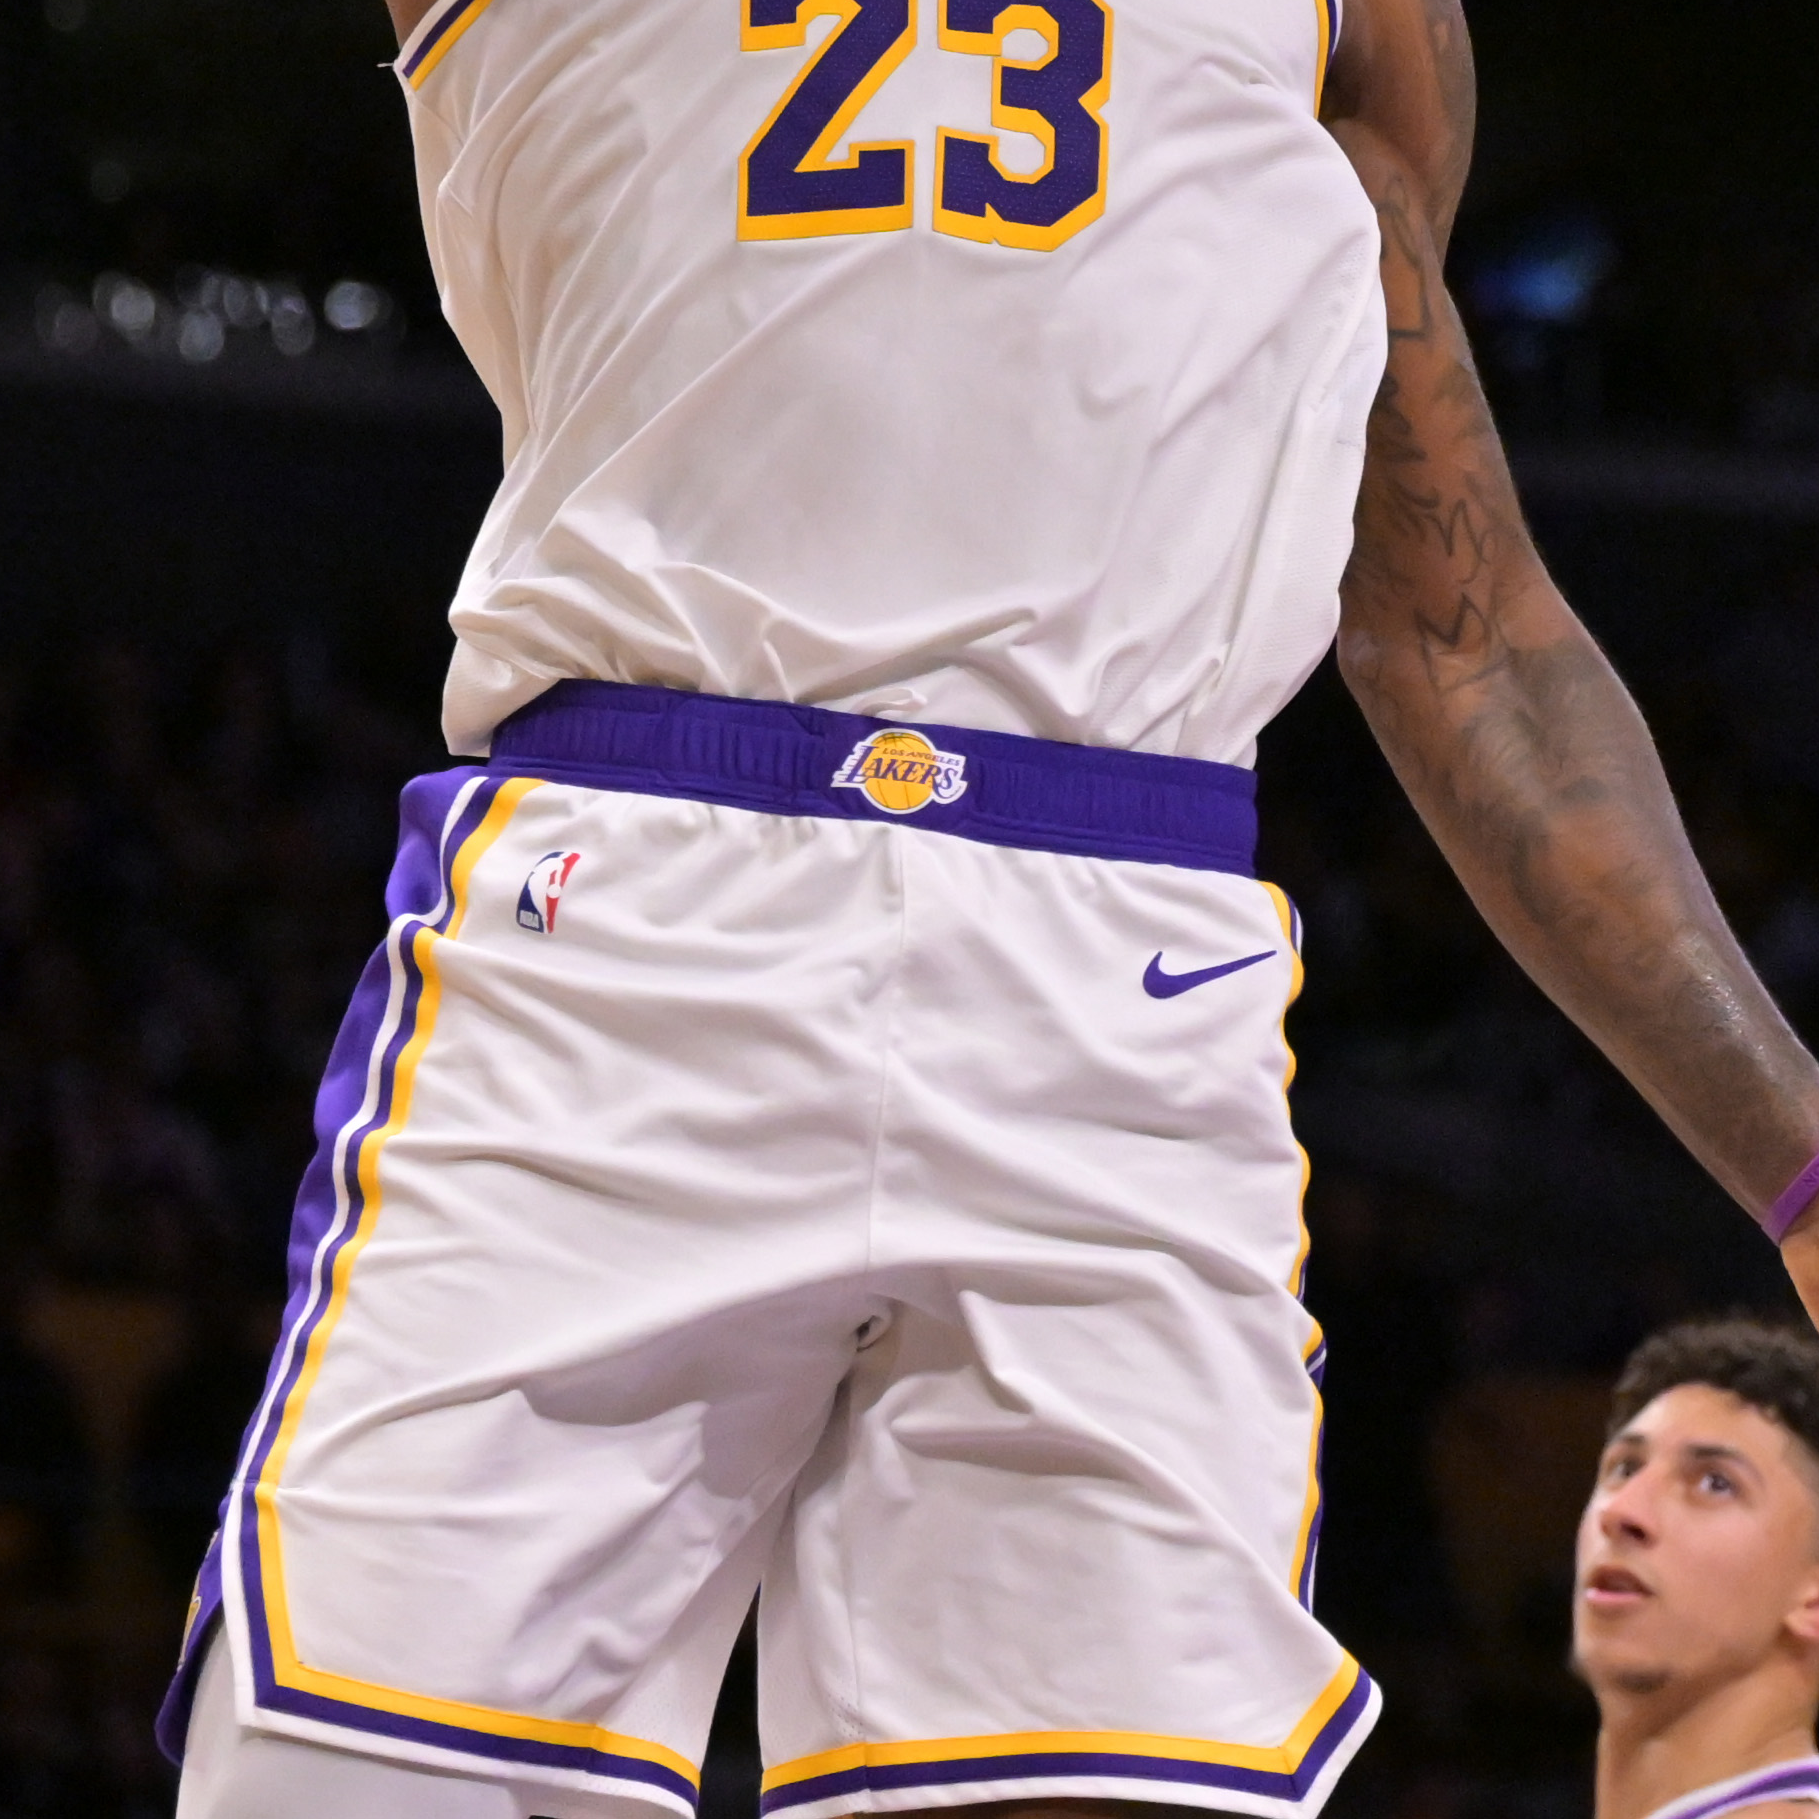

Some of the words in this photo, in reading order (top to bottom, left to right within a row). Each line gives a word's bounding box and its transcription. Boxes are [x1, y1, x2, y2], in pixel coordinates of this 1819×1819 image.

[838, 745, 963, 799] LAKERS
[882, 747, 905, 757] LOS
[906, 751, 961, 767] ANGELES
